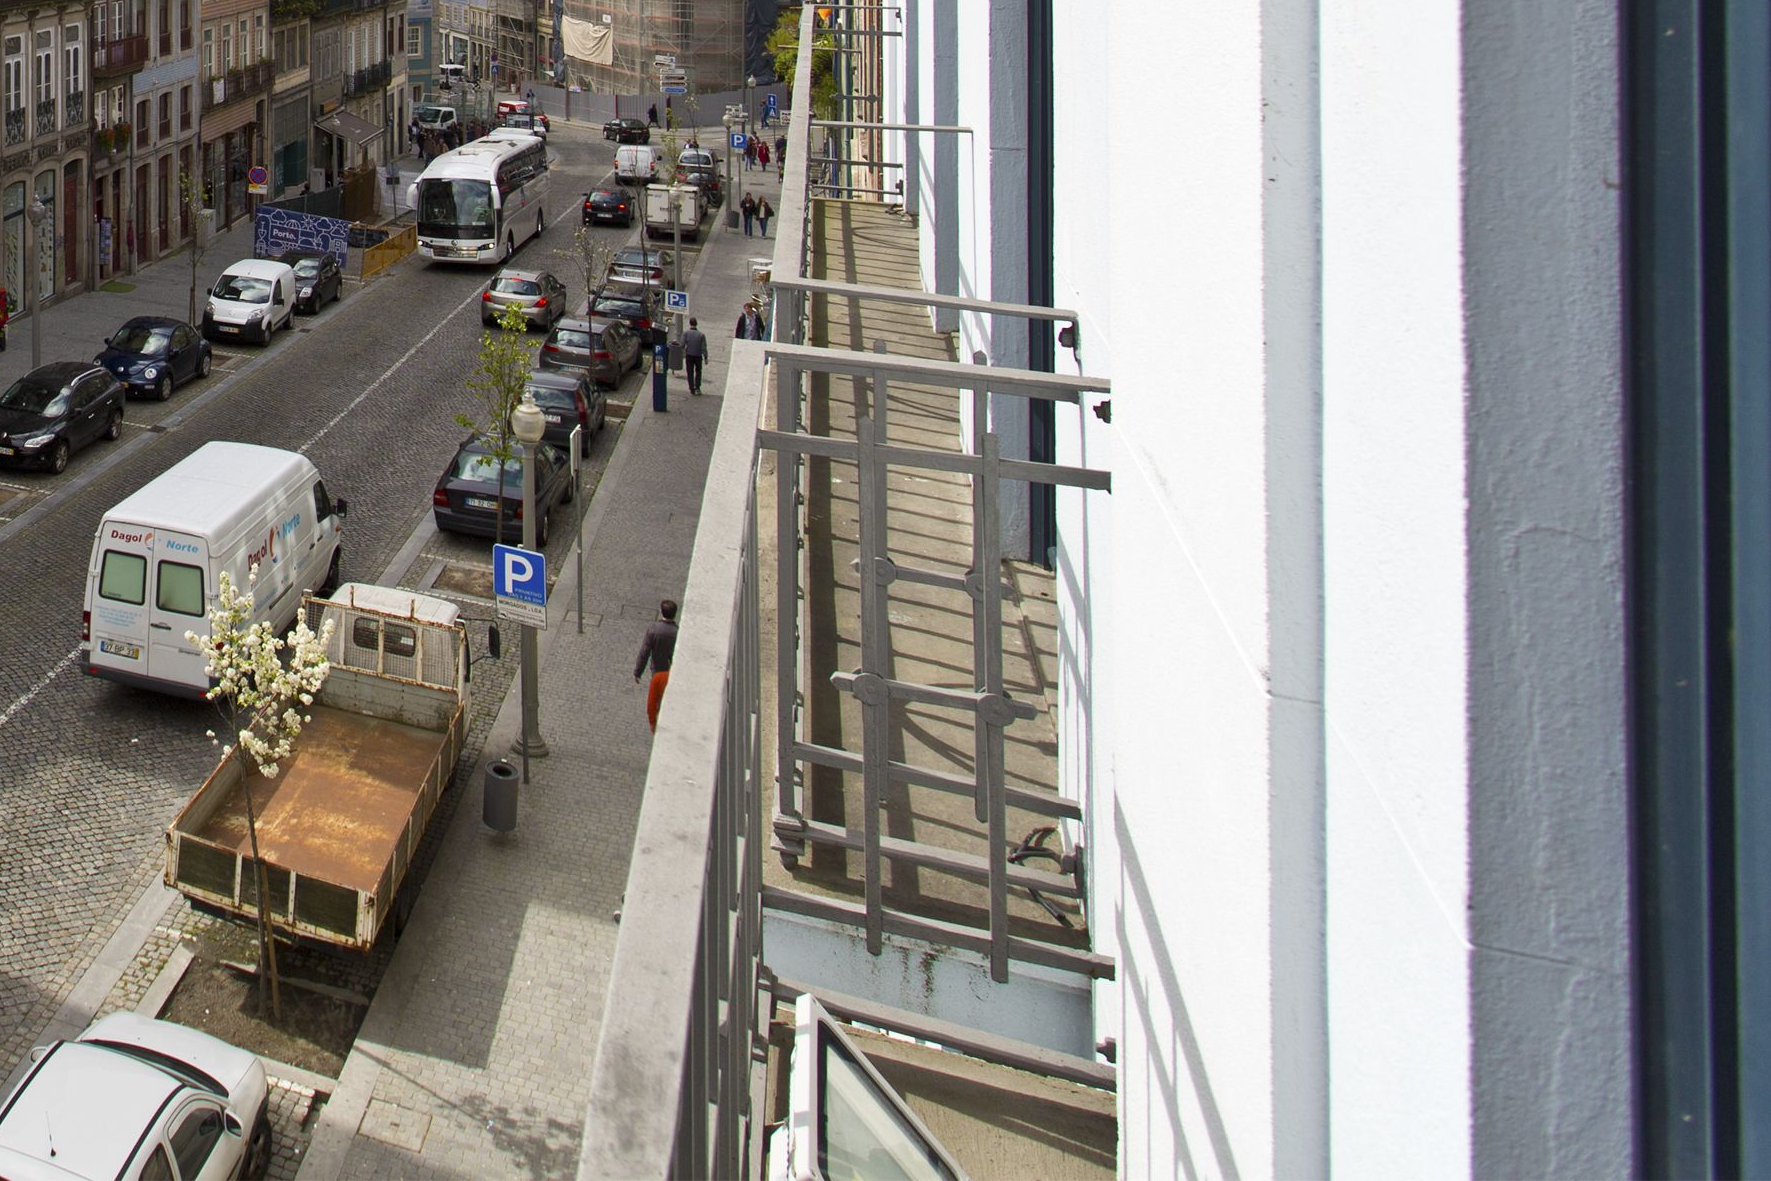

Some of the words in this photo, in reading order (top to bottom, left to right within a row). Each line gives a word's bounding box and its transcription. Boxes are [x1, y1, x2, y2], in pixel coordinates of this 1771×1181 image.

[734, 134, 744, 146] P
[273, 229, 296, 240] Porto.
[110, 529, 143, 543] Dagol
[166, 540, 199, 554] Norte
[504, 552, 533, 593] P
